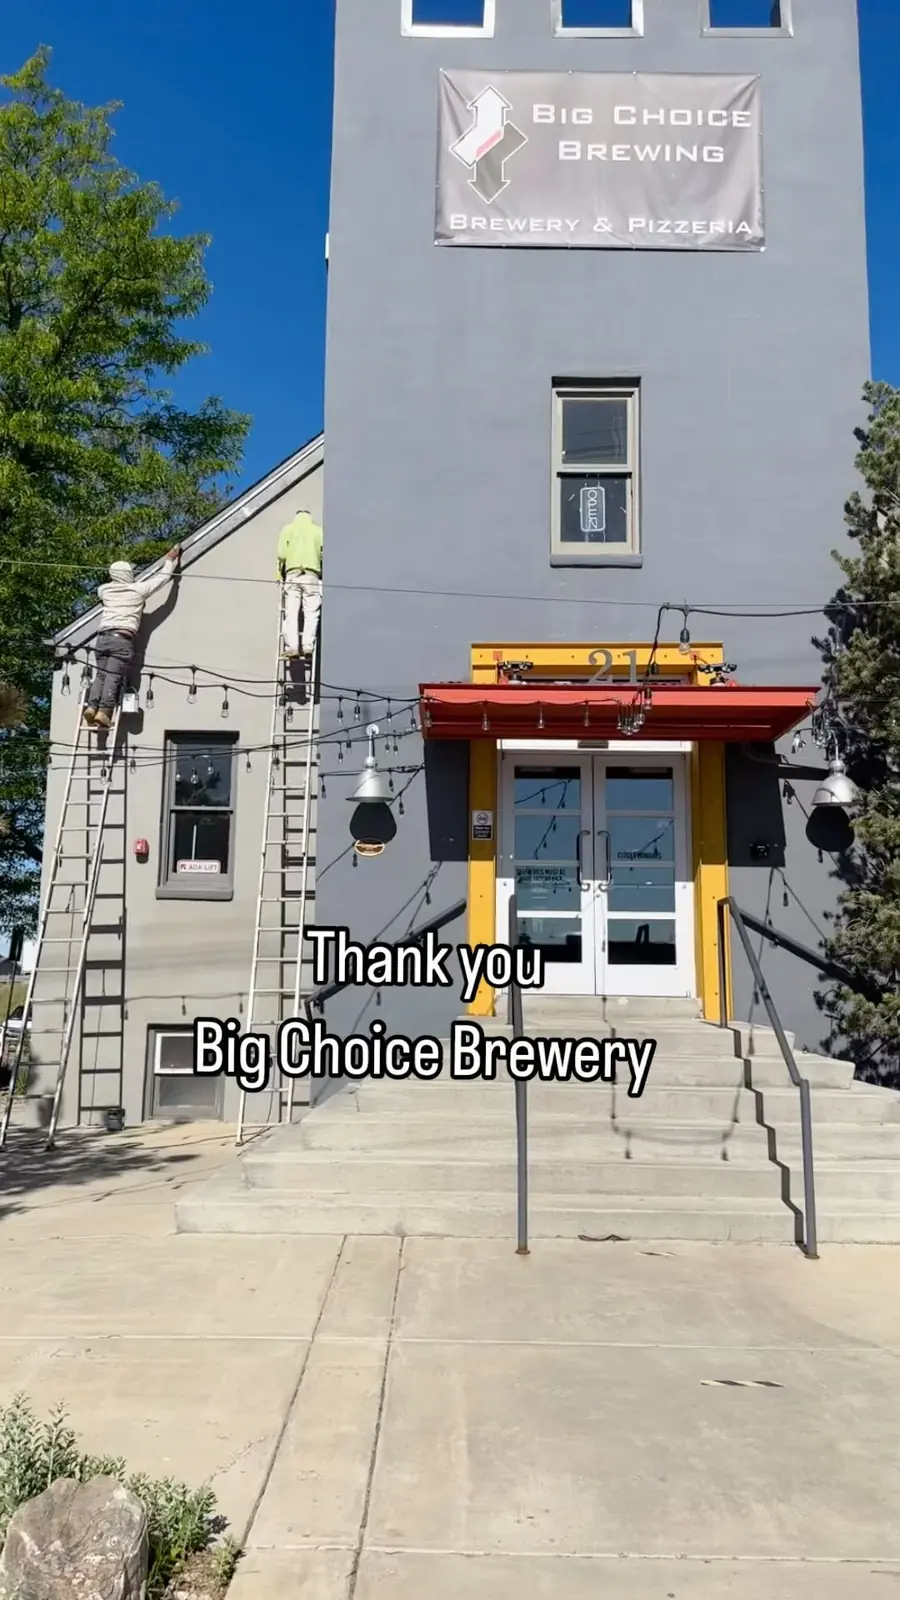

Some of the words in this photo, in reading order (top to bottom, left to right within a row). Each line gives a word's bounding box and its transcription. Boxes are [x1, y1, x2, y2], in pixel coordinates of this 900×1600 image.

[532, 103, 593, 125] BIG
[613, 105, 752, 128] CHOICE
[558, 140, 725, 163] BREWING
[449, 214, 580, 232] BREWERY
[592, 217, 612, 233] &
[628, 217, 753, 235] PIZZERIA
[587, 489, 598, 530] OPEN
[588, 648, 639, 684] 21
[189, 863, 202, 871] ADA
[204, 863, 218, 871] LIFT
